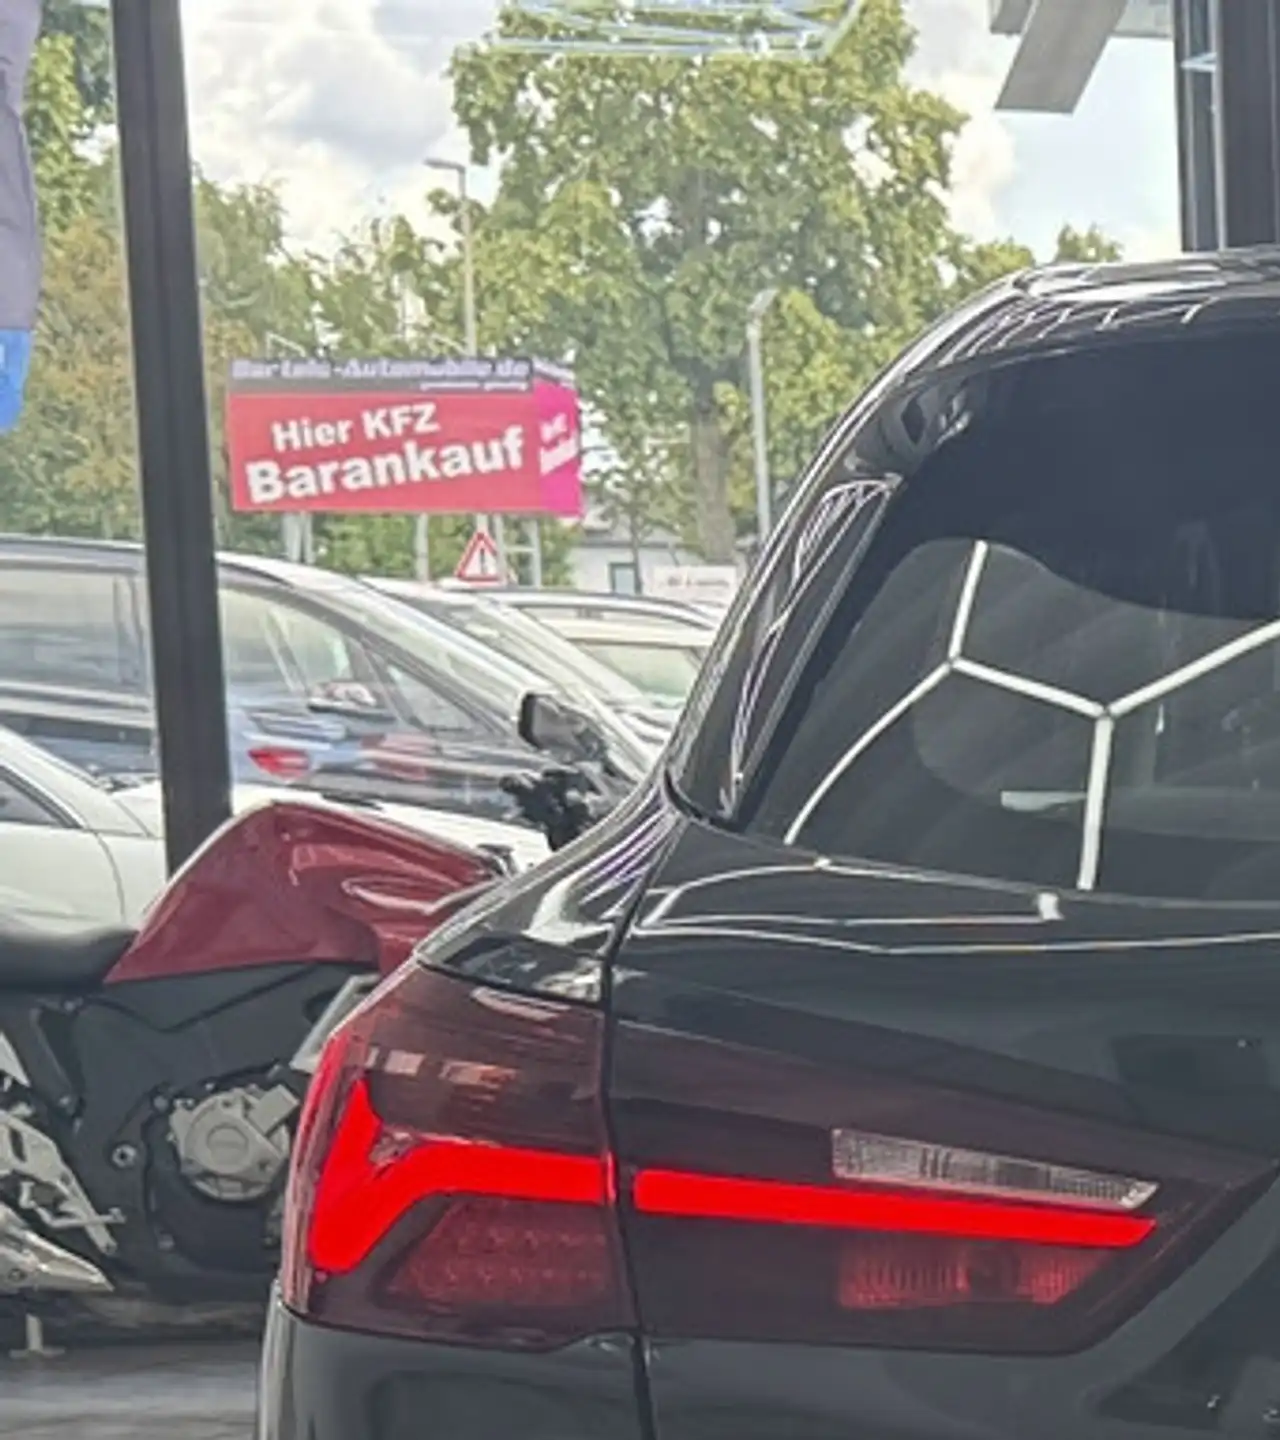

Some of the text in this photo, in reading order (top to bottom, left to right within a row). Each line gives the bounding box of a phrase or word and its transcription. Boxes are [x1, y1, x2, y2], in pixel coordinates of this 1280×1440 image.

[270, 401, 441, 453] Hier KFZ
[244, 426, 525, 504] Barankauf
